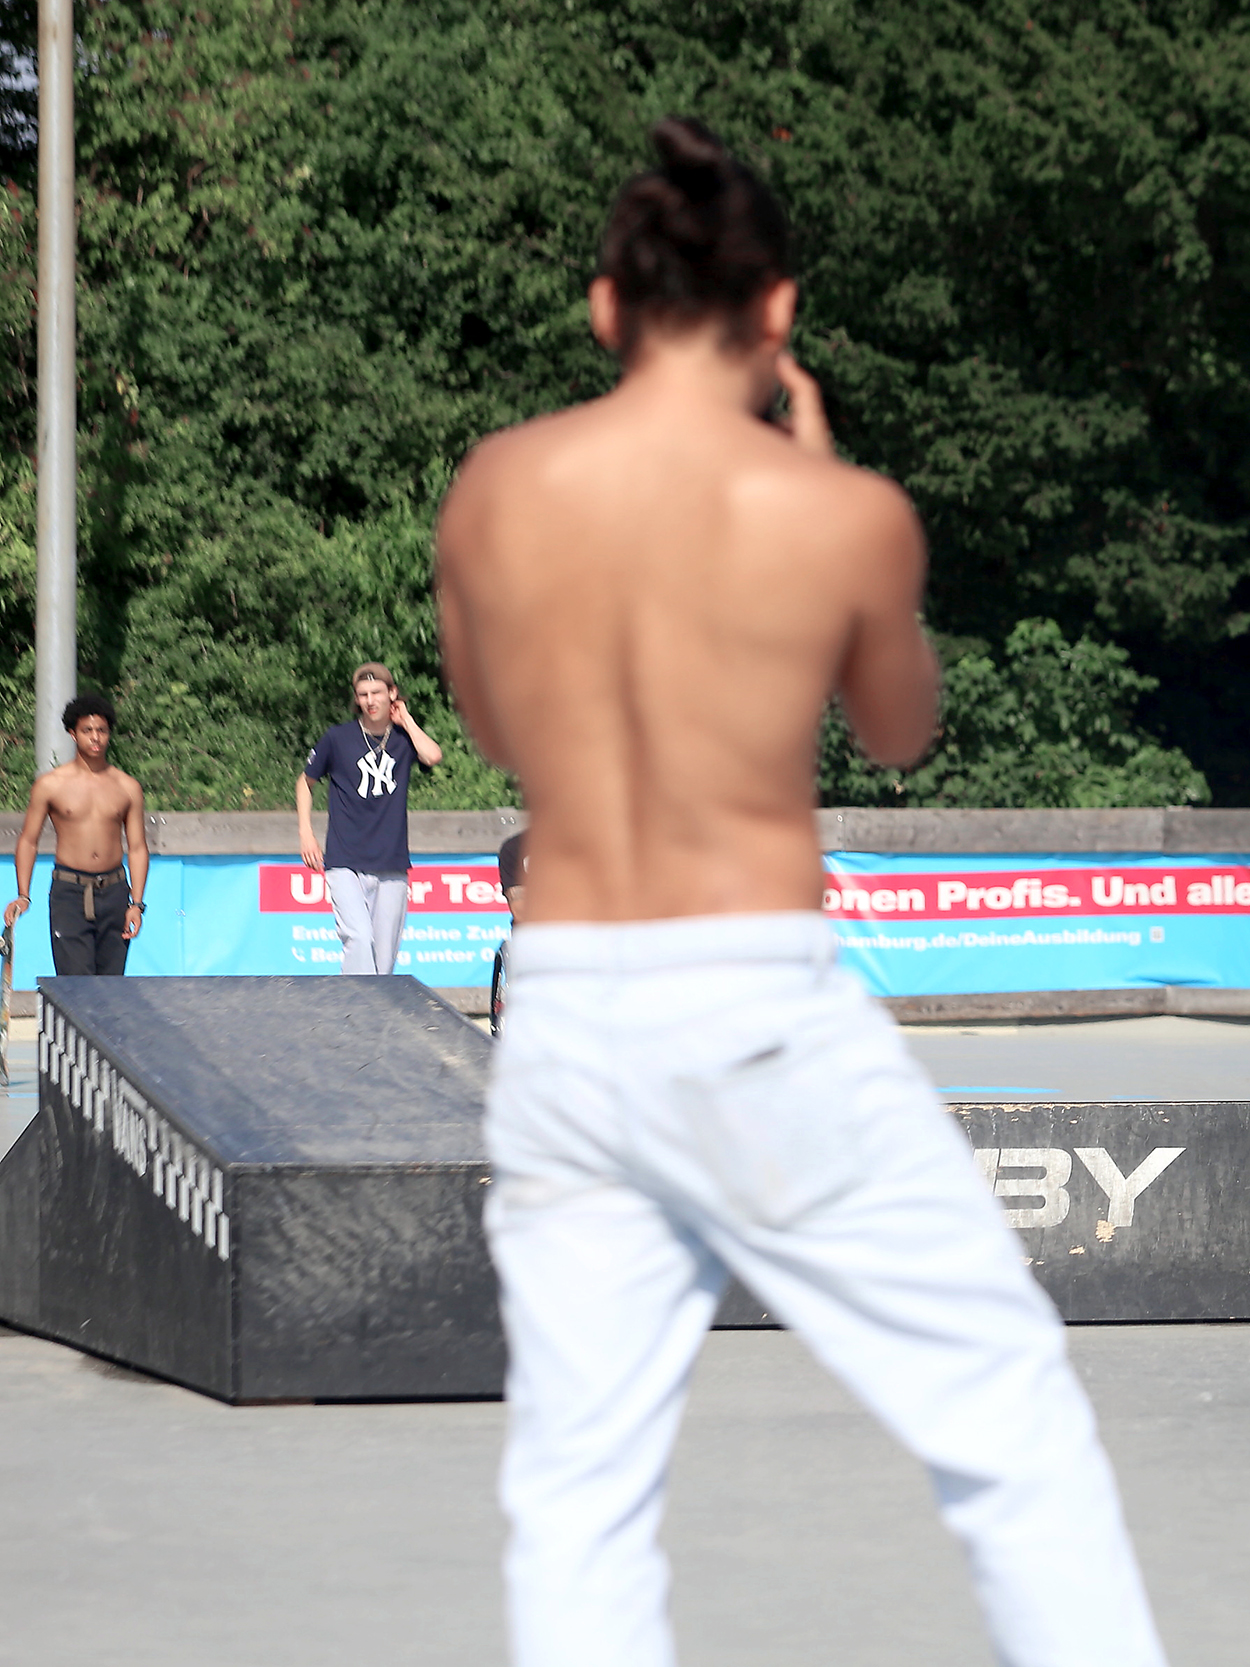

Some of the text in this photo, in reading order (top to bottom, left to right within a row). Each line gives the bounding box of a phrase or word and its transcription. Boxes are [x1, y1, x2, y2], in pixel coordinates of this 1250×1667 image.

[357, 750, 397, 798] NY
[822, 887, 925, 912] onen
[937, 878, 1081, 911] Profis.
[1091, 876, 1177, 907] Und
[836, 928, 1141, 952] hamburg.de/DeineAusbildung
[974, 1147, 1187, 1229] BY
